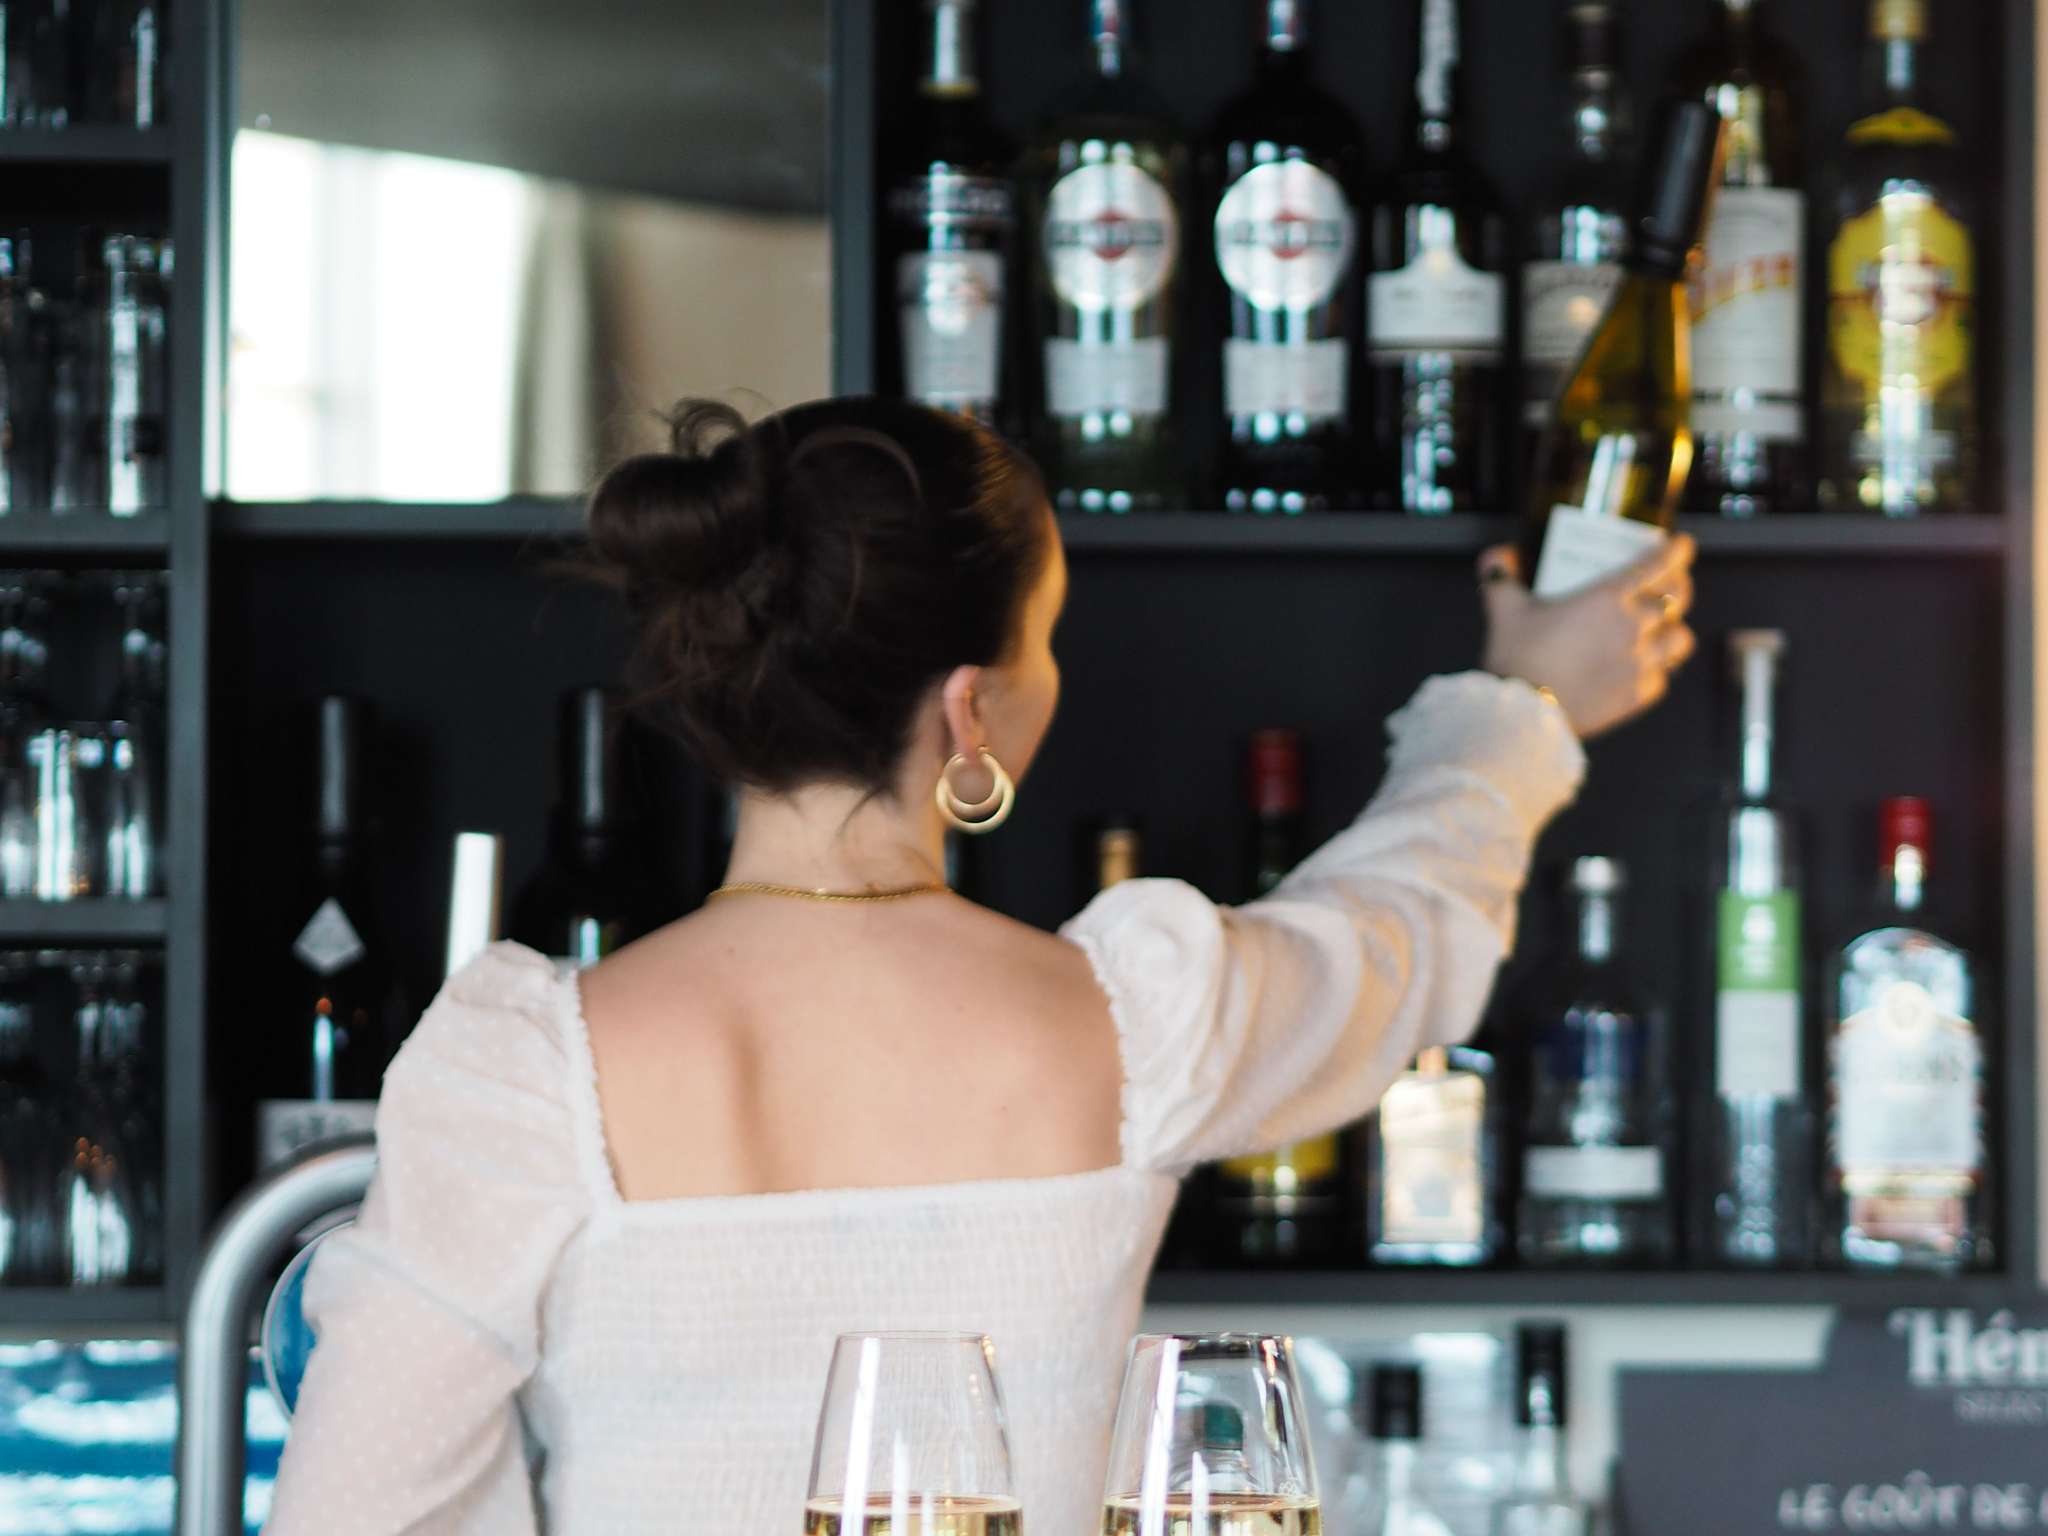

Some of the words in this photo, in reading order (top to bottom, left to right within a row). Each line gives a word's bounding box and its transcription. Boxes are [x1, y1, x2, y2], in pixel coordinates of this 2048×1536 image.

[1779, 1484, 1833, 1530] LE
[1842, 1470, 1965, 1530] GOÛT
[1972, 1483, 2032, 1530] DE
